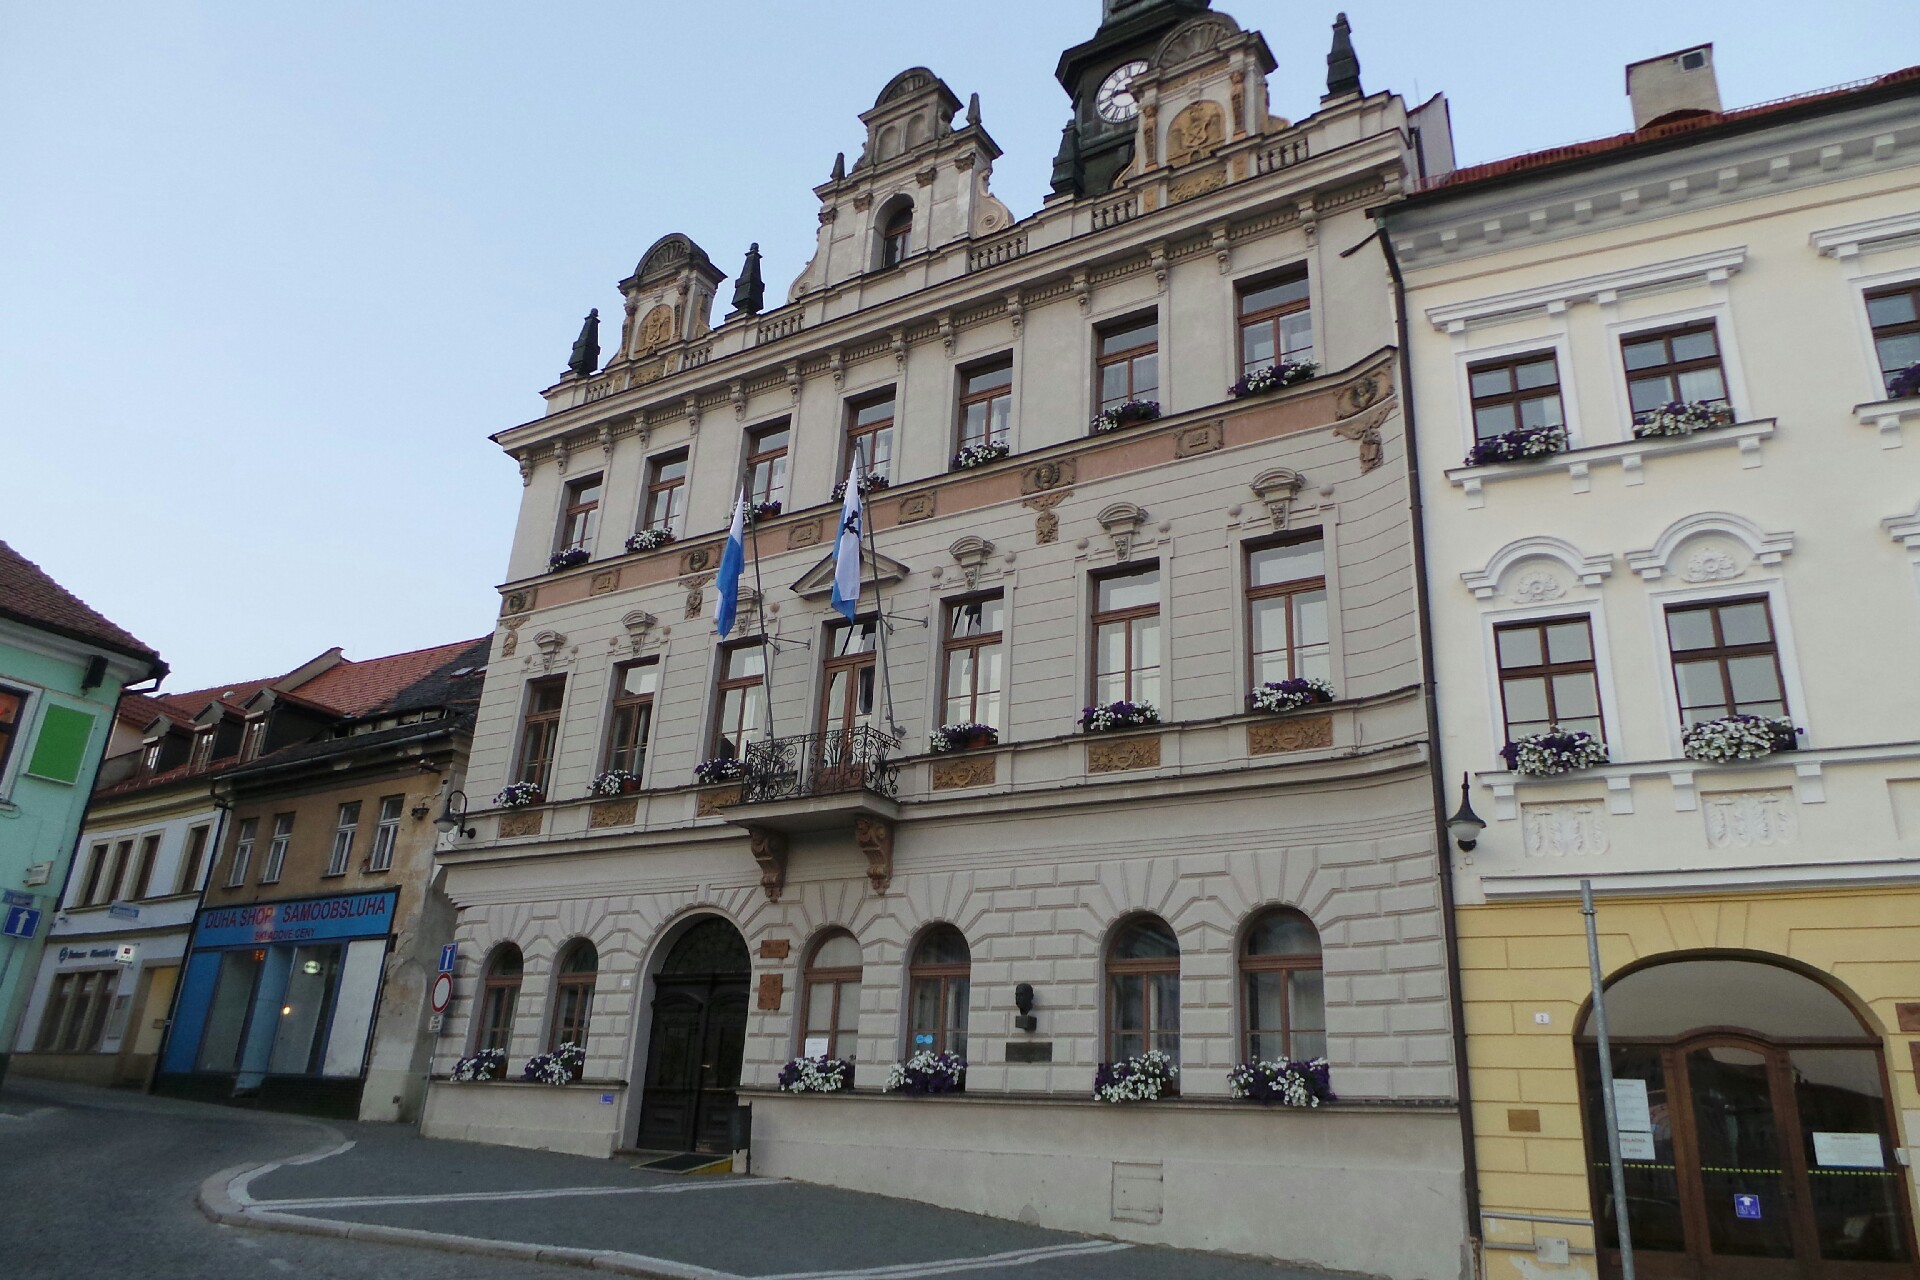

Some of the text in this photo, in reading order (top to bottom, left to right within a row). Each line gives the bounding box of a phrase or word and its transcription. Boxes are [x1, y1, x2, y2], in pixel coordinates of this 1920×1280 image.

[205, 896, 386, 929] DUHA SHOP SAMOOBSLUHA
[295, 928, 316, 939] CENY
